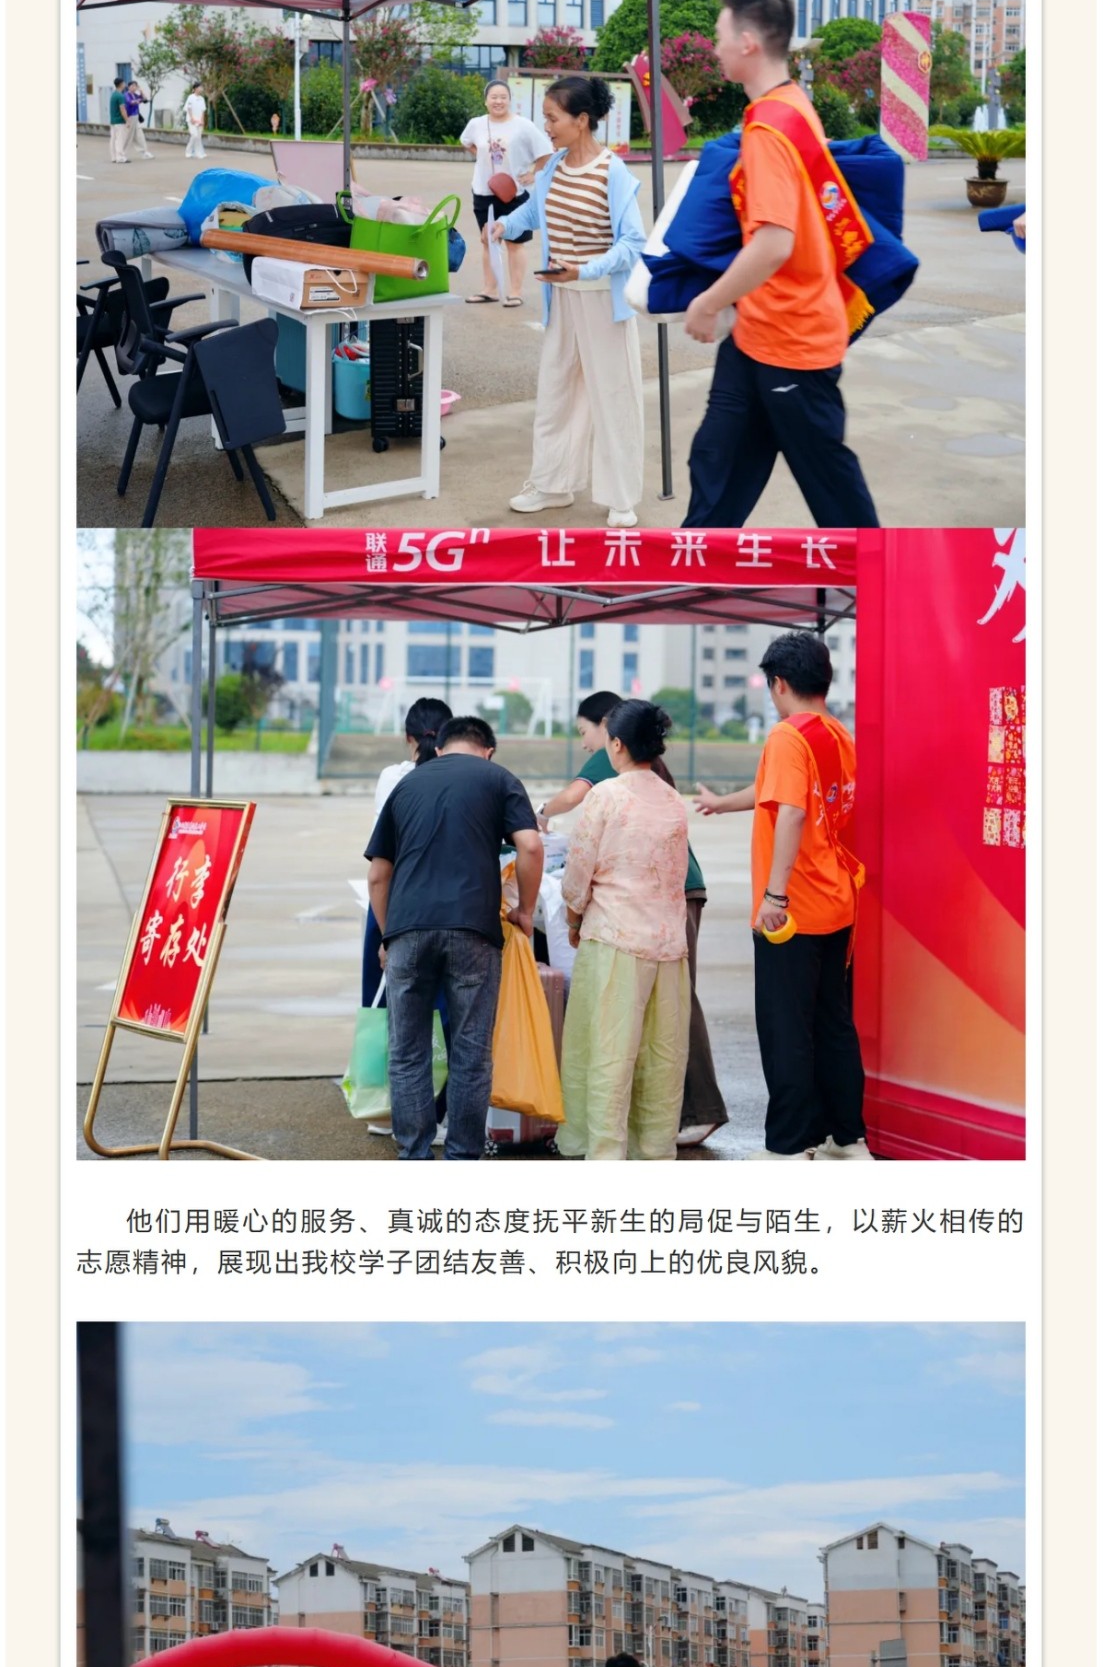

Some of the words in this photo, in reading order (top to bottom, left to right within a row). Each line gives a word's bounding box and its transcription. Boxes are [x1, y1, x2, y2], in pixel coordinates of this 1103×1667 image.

[365, 532, 388, 572] 联通
[539, 529, 839, 570] 让未来生长
[166, 854, 212, 909] 行李
[140, 909, 208, 968] 寄存处
